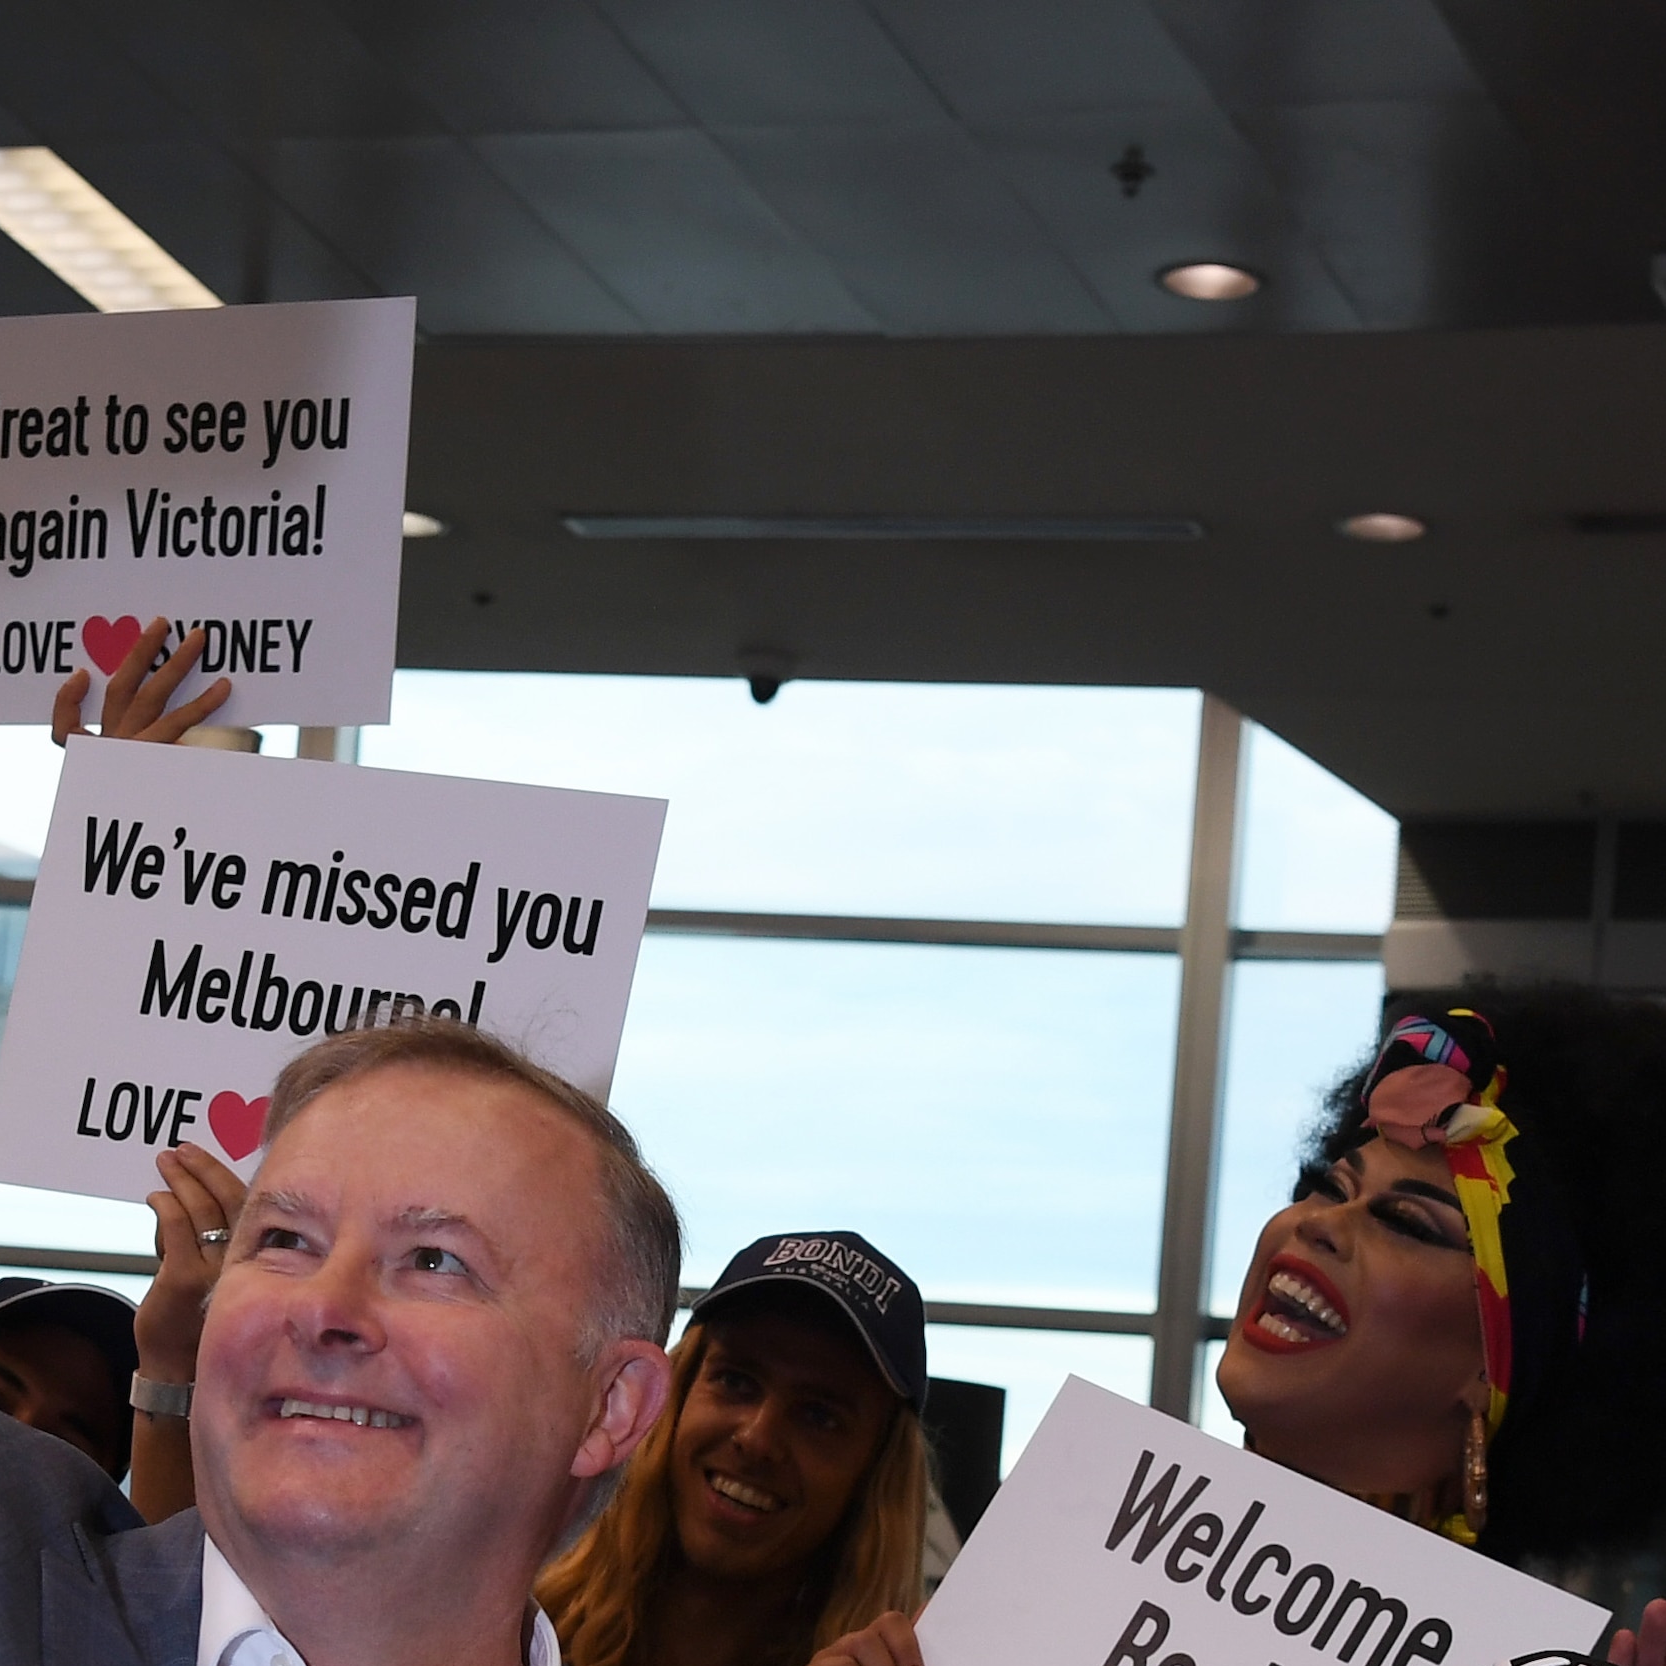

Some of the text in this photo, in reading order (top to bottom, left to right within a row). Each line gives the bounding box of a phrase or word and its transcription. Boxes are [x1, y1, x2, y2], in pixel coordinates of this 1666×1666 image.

[105, 394, 149, 456] to
[163, 400, 247, 454] see
[262, 397, 350, 470] you
[126, 484, 327, 559] Victoria!
[84, 815, 604, 964] We've missed you
[78, 1078, 201, 1148] LOVE
[763, 1238, 901, 1314] BONDI
